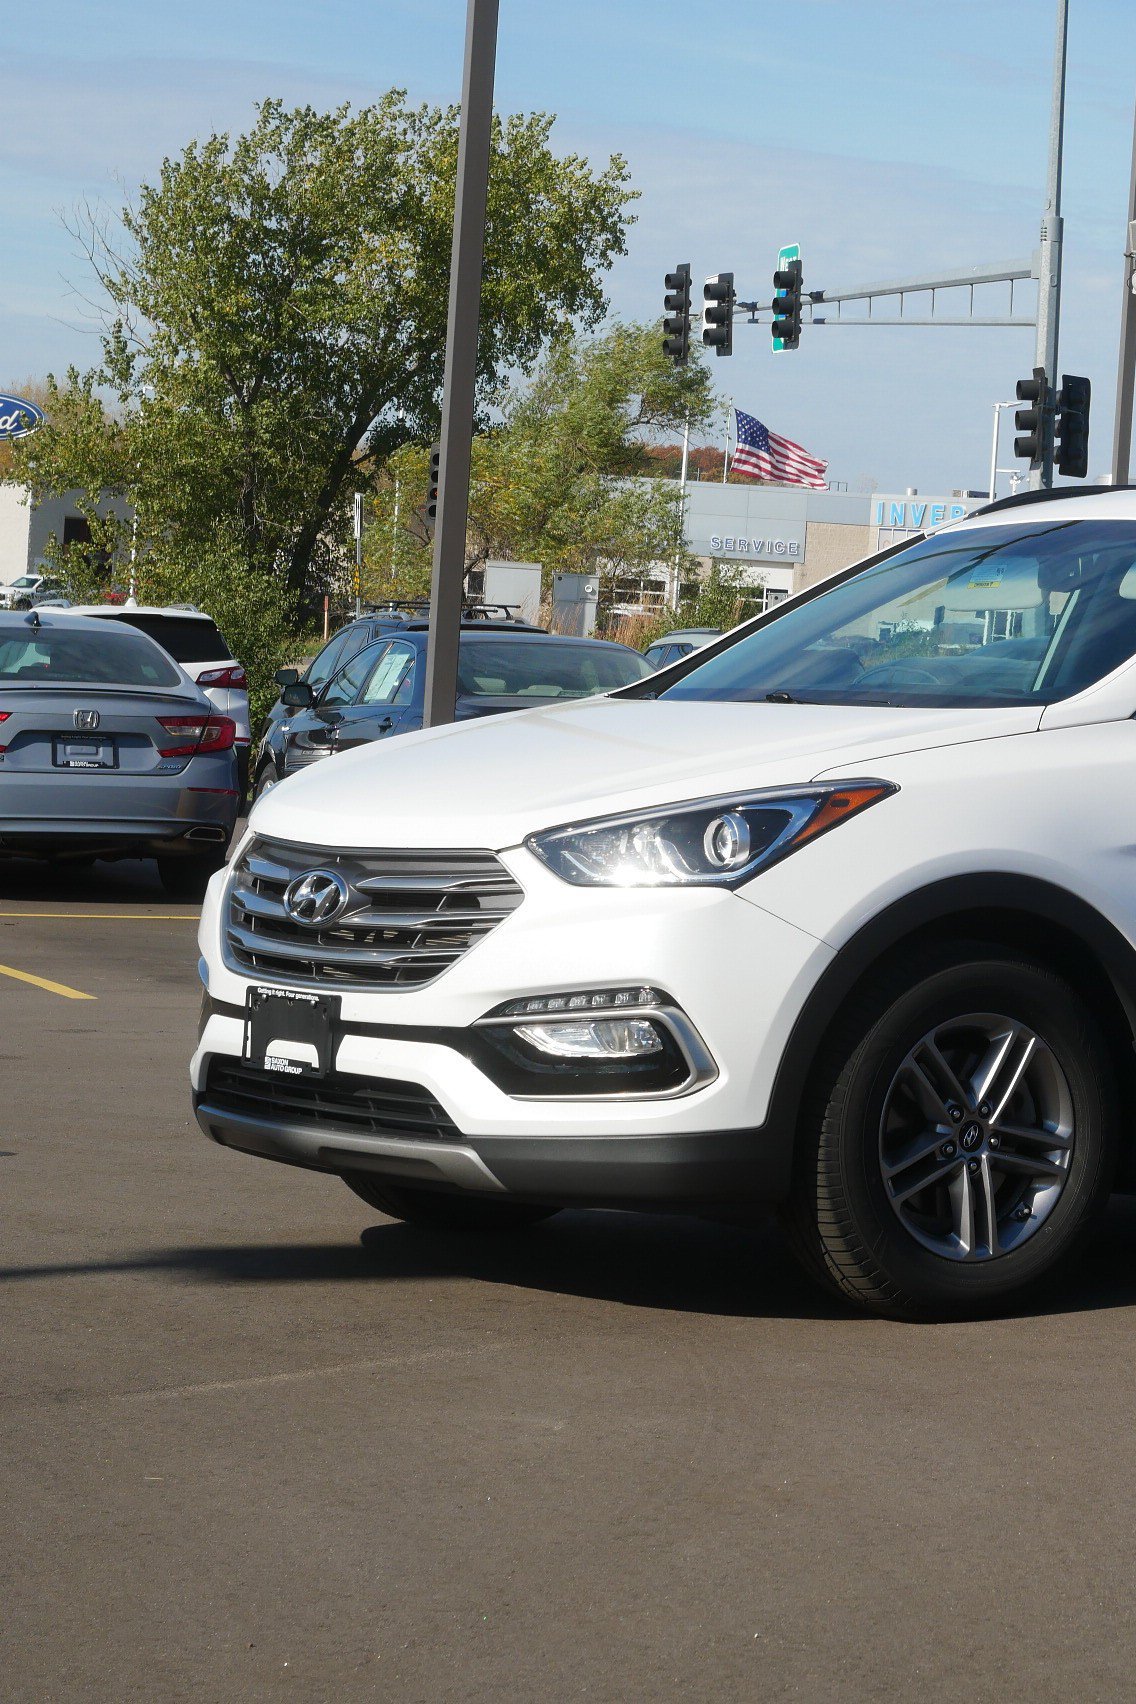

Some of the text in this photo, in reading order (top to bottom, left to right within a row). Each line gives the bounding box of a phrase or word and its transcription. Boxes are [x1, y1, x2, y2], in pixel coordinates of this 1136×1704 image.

[711, 536, 798, 554] SERVICE
[271, 1064, 302, 1074] AUTO GROUP
